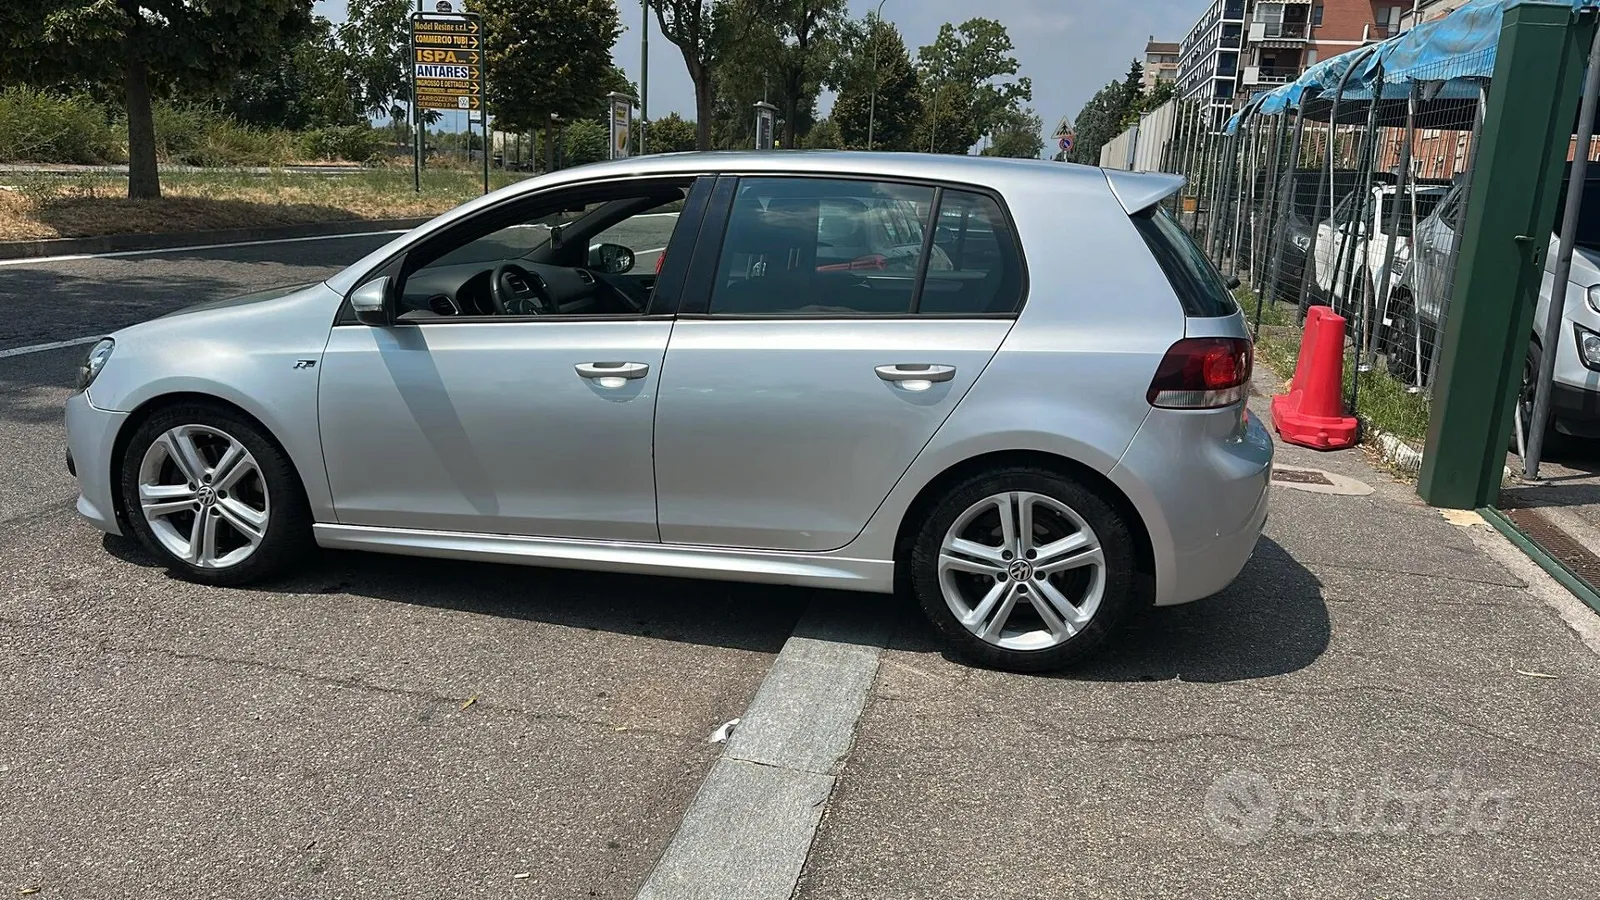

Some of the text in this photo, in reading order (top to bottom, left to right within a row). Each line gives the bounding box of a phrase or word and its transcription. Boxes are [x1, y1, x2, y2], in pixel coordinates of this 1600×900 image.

[434, 22, 454, 31] Resine
[415, 34, 468, 44] COMMERCIO TUBI
[416, 49, 458, 63] ISPA
[417, 65, 468, 78] ANTARES
